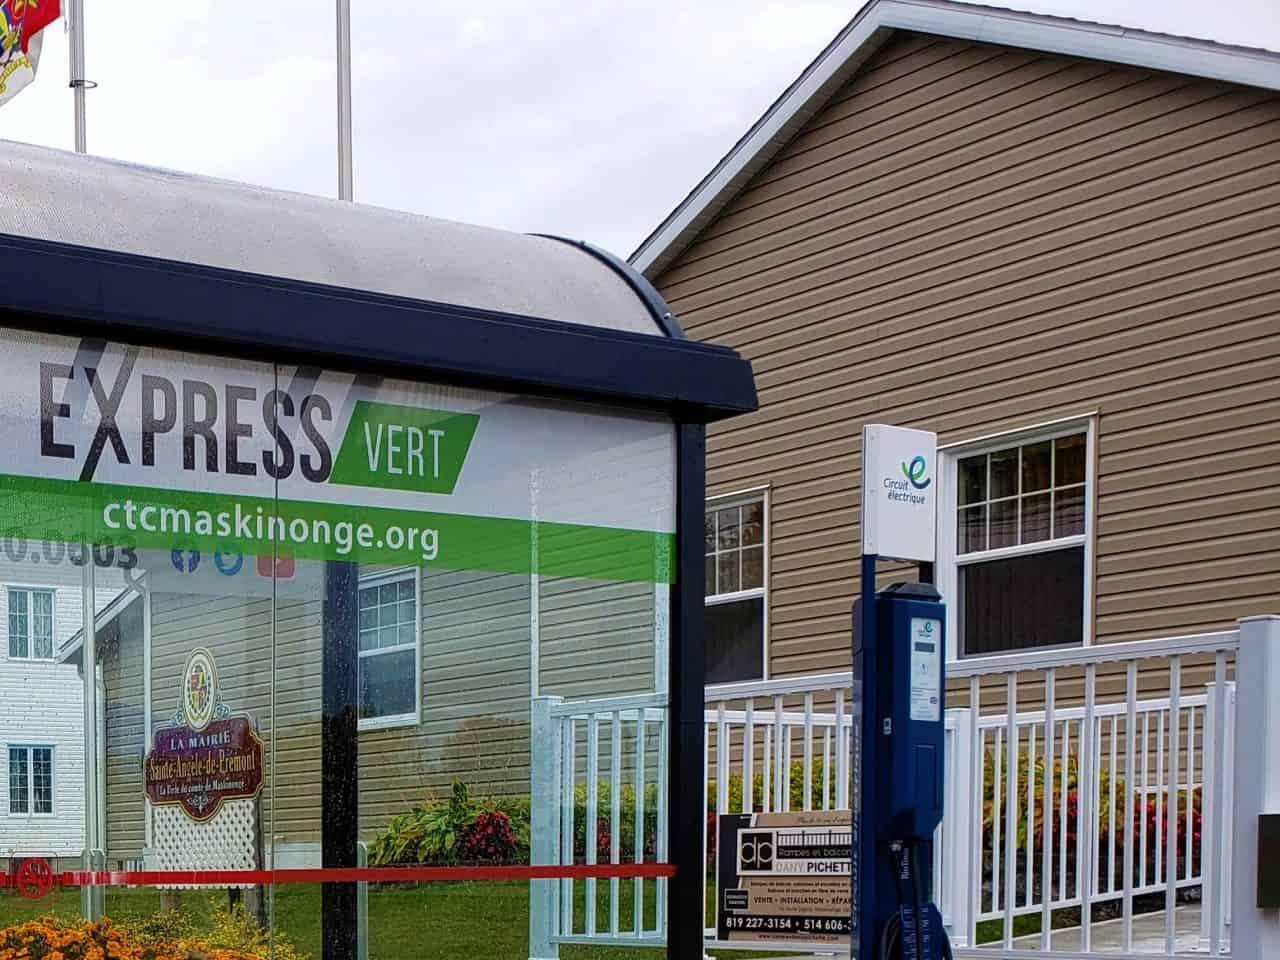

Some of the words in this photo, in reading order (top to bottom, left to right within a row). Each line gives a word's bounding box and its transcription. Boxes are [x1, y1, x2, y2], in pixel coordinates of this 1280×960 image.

[39, 349, 333, 482] EXPRESS
[363, 421, 445, 479] VERT
[883, 478, 909, 491] Circuit
[103, 500, 439, 559] ctcmaskinonge.org
[170, 738, 184, 751] LA
[189, 731, 231, 748] MAIRIE
[807, 862, 852, 873] PICHETT
[726, 918, 743, 928] 819
[746, 918, 791, 929] 227-3154
[804, 920, 822, 929] 514
[825, 920, 852, 931] 606-3
